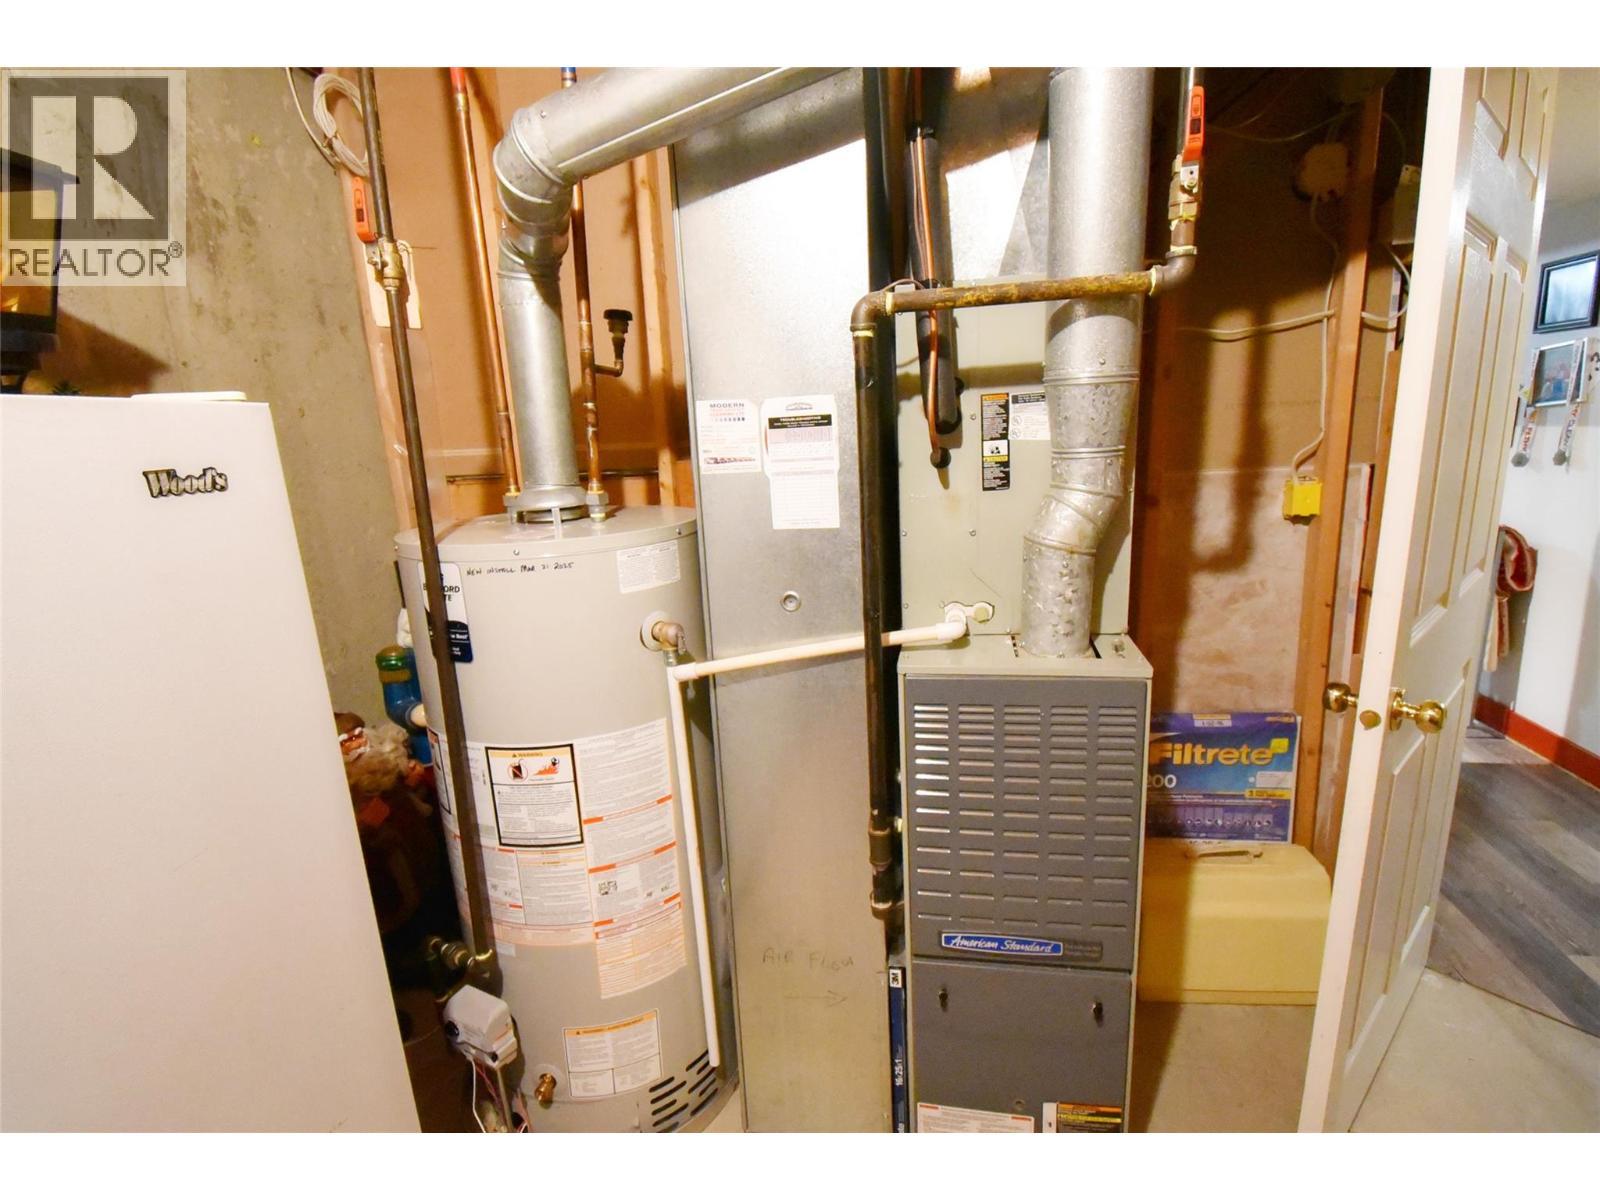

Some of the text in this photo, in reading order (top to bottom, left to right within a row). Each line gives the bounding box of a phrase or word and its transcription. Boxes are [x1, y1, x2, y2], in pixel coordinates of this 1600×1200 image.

[142, 466, 228, 498] Wood's
[466, 568, 482, 576] NEW
[553, 561, 575, 570] 2025
[1150, 742, 1273, 766] Filtrete
[950, 935, 998, 949] American
[1000, 938, 1054, 953] Standard
[891, 972, 899, 986] 3M
